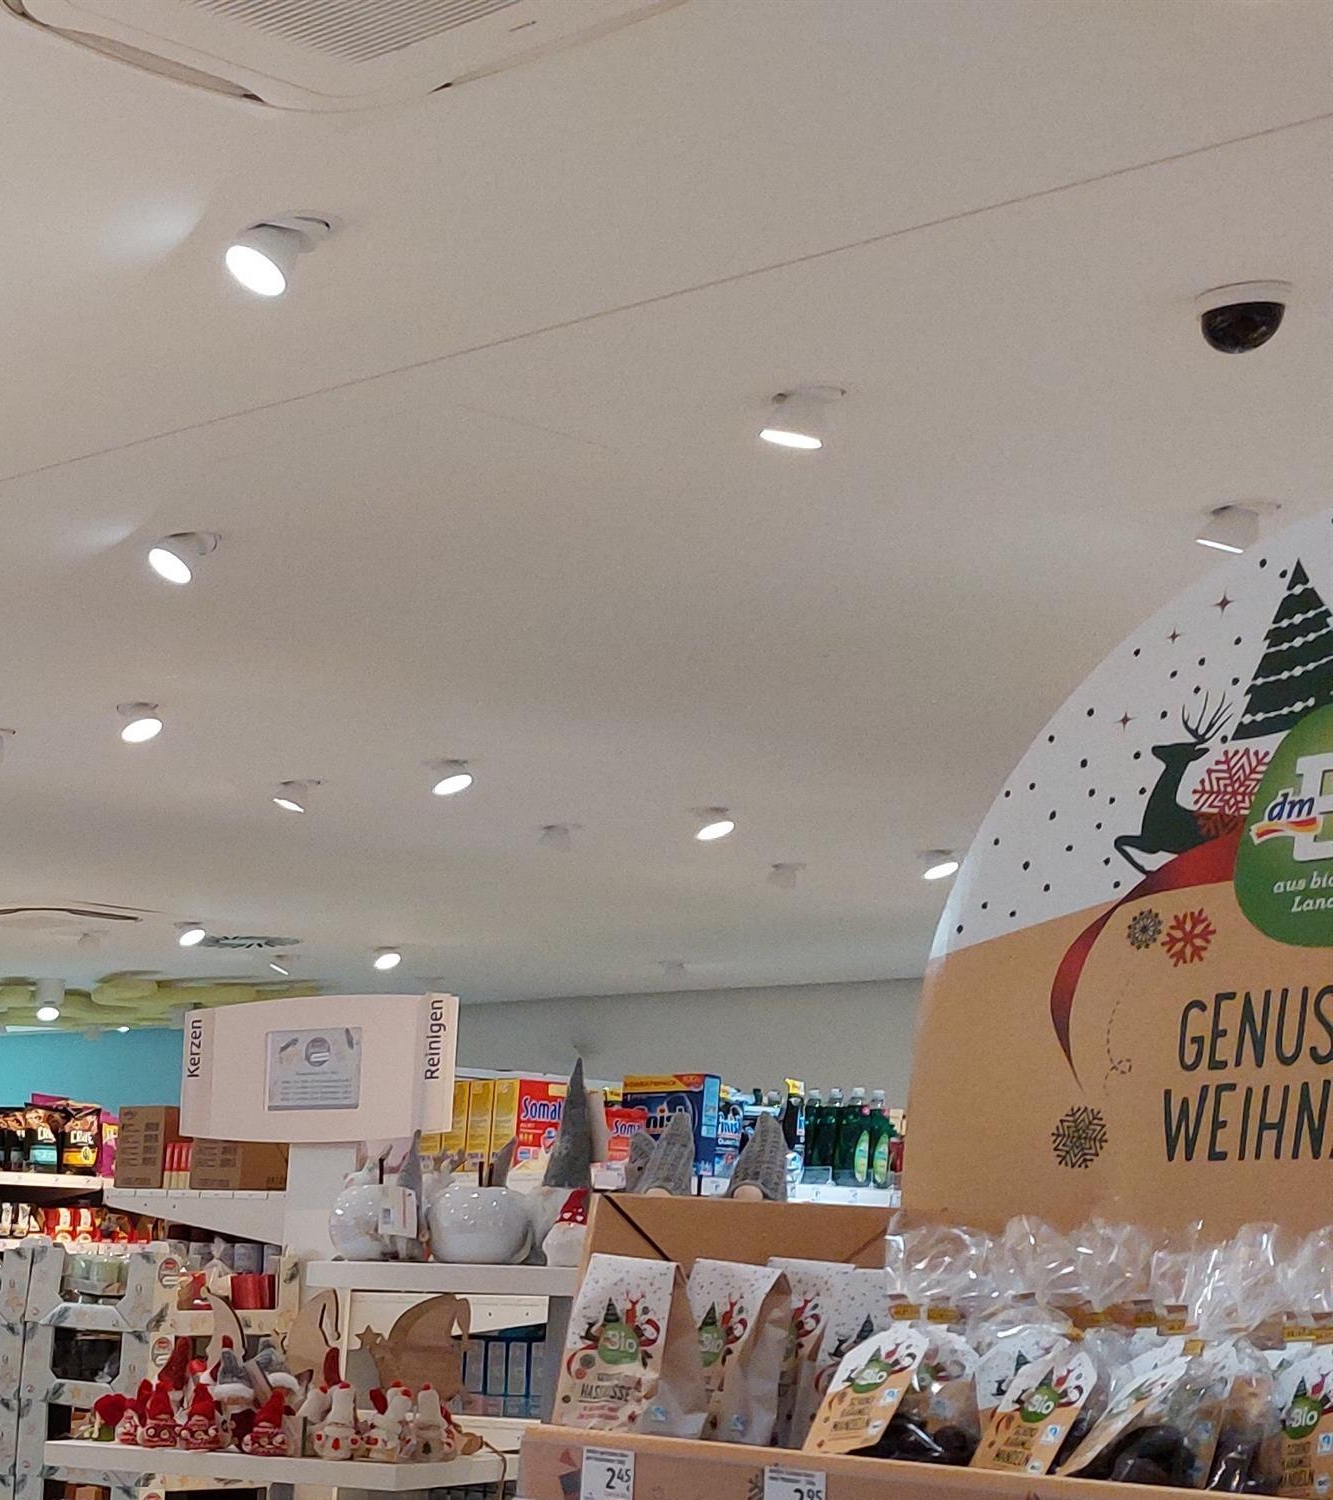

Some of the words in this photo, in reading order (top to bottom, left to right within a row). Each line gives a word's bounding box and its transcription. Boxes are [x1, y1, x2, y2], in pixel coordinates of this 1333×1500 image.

[1273, 877, 1307, 894] aus
[187, 1018, 203, 1079] Kerzen
[424, 999, 447, 1081] Reinigen
[1179, 986, 1333, 1073] GENUS
[522, 1096, 564, 1119] Somat
[1164, 1078, 1333, 1163] WEIHN
